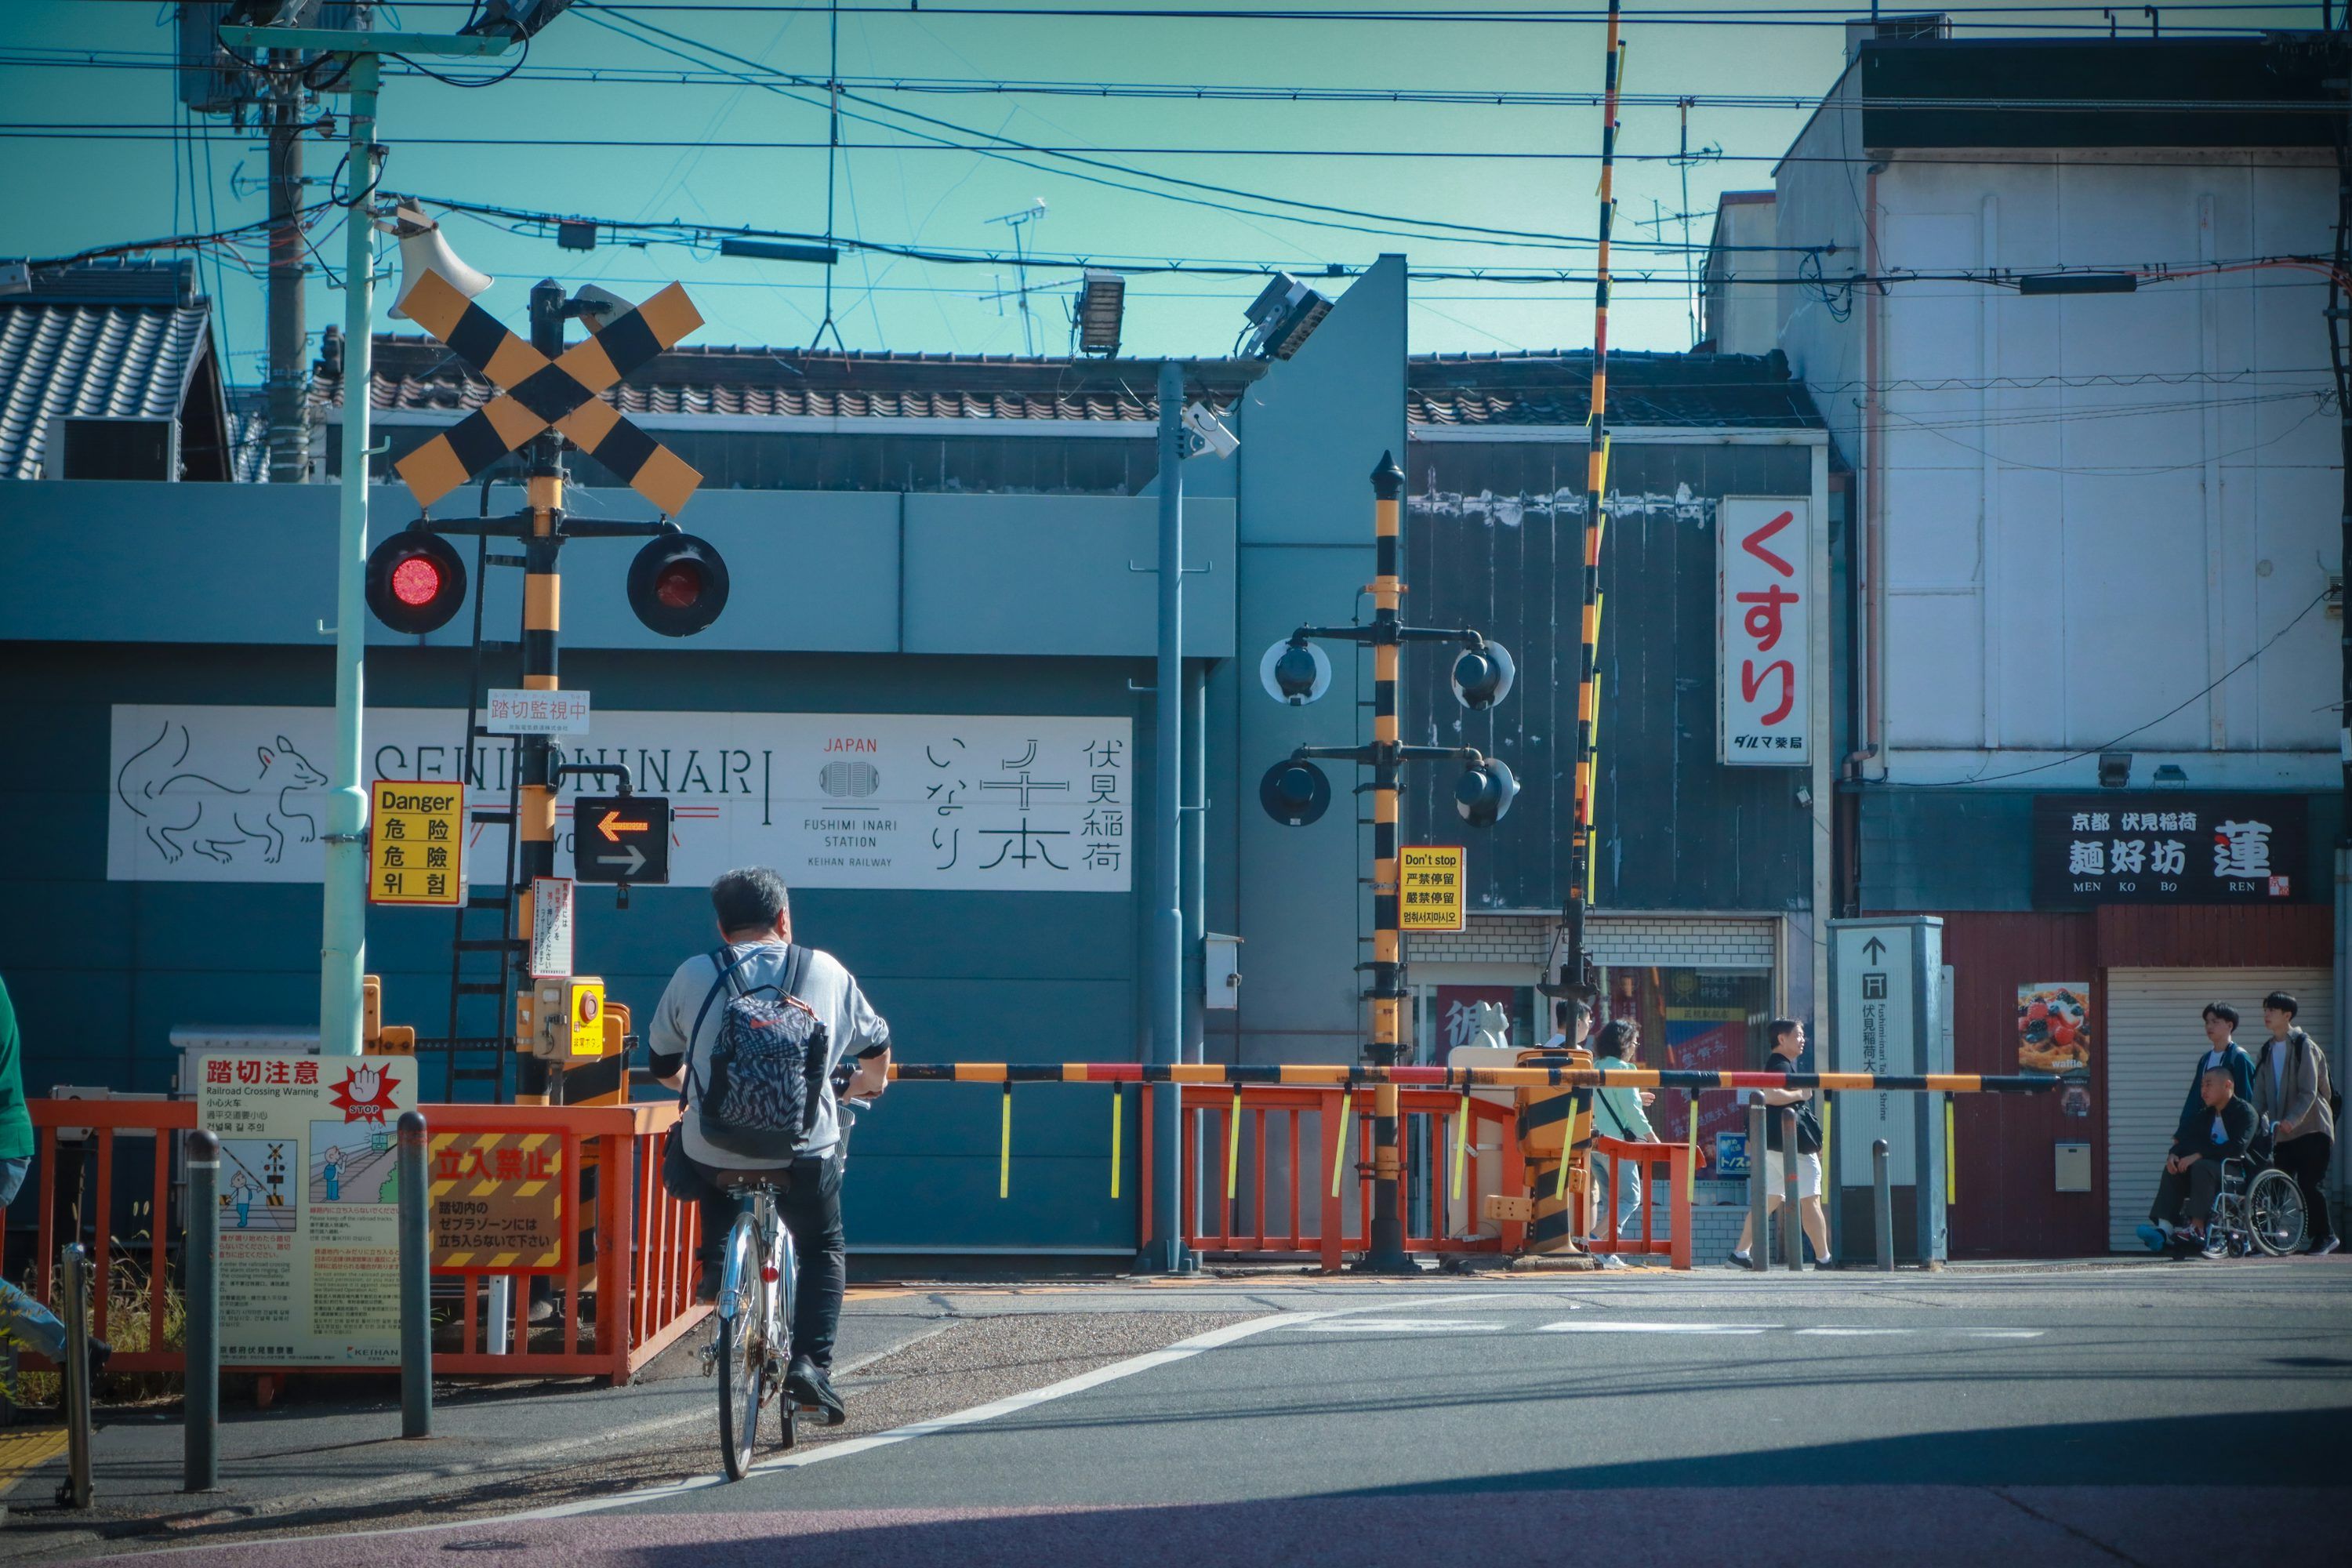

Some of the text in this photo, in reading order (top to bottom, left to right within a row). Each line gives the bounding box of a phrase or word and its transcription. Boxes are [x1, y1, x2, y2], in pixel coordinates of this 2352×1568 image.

[1736, 510, 1799, 726] くすり
[492, 699, 586, 720] 踏切監視中
[823, 738, 877, 753] JAPAN
[1733, 734, 1802, 750] ダルマ薬局
[382, 791, 455, 812] Danger
[1080, 739, 1123, 873] 伏見稲荷
[804, 818, 897, 833] FUSHIMI INARI
[2072, 812, 2197, 832] 京都 伏見稲荷
[825, 836, 877, 848] STATION
[2213, 820, 2273, 878] 蓮
[808, 857, 892, 867] KEIHAN RAILWAY
[1406, 854, 1456, 866] Don't stop
[2069, 839, 2186, 876] 麺好坊
[1406, 873, 1454, 885] 严禁停留
[2074, 882, 2178, 892] MEN KO BO
[2229, 882, 2256, 891] REN
[1406, 892, 1454, 904] 嚴禁停留
[1404, 912, 1456, 923] 멈춰서지마시오
[1862, 1004, 1876, 1073] 伏見稲荷大
[1878, 1004, 1887, 1061] Fushimi-inari
[2052, 1059, 2083, 1069] waffle
[207, 1060, 319, 1084] 踏切注意
[245, 1087, 280, 1098] Crossing
[283, 1087, 318, 1098] Warning
[207, 1123, 232, 1132] 건널목
[248, 1123, 264, 1131] 주의
[437, 1146, 552, 1181] 立入禁止
[439, 1201, 488, 1214] 踏切内の
[439, 1218, 536, 1231] ゼブラゾーンには
[439, 1235, 549, 1248] 立ち入らないで下さい
